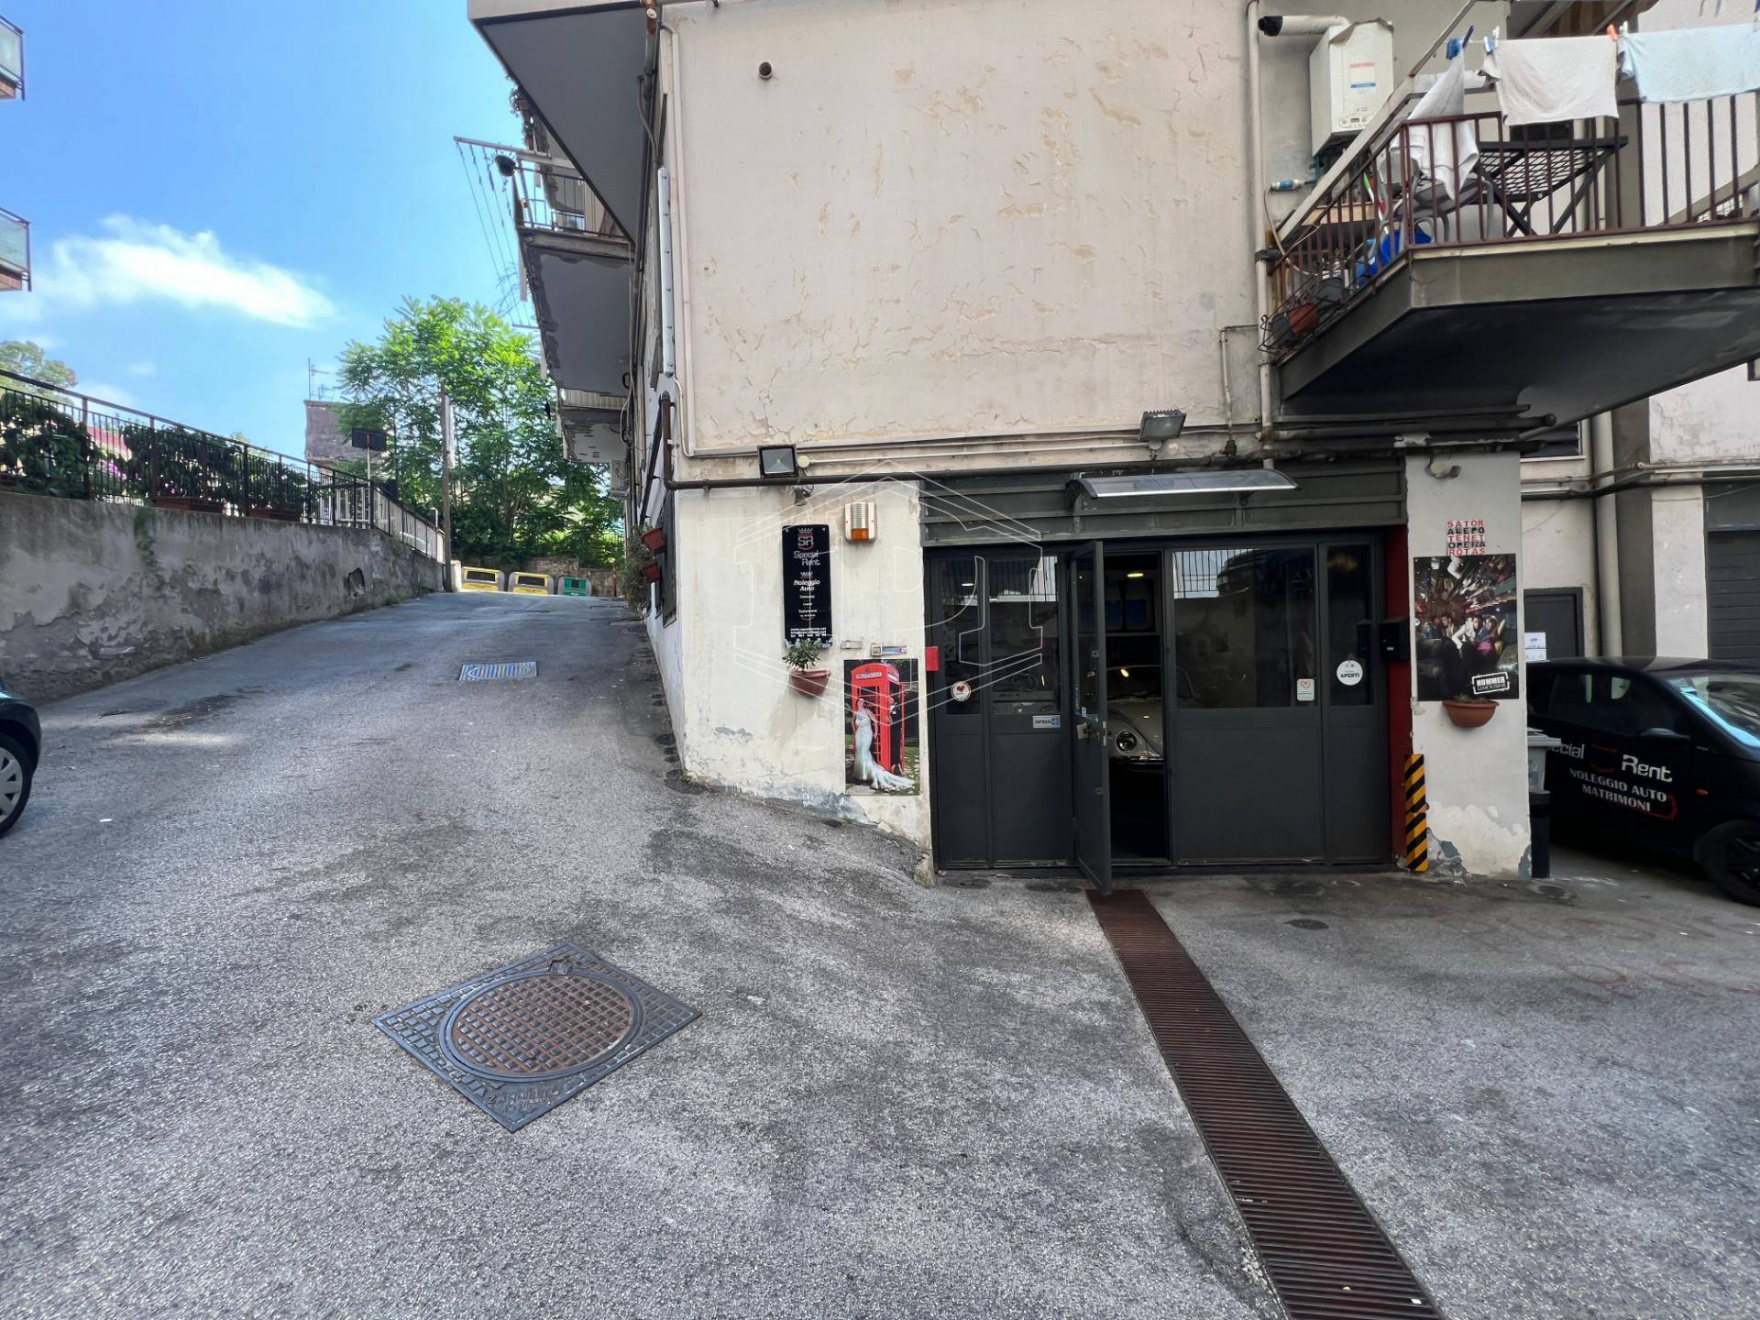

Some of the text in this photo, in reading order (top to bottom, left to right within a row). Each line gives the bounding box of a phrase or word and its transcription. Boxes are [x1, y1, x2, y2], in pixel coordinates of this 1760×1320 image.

[1447, 520, 1484, 528] SATOR
[1448, 534, 1484, 542] TENET
[1448, 541, 1486, 549] OPERA
[1449, 548, 1486, 556] ROTAS
[1621, 754, 1673, 782] Rent
[1569, 768, 1667, 802] NOLEGGIO AUTO
[1582, 784, 1651, 811] MATRIMONI
